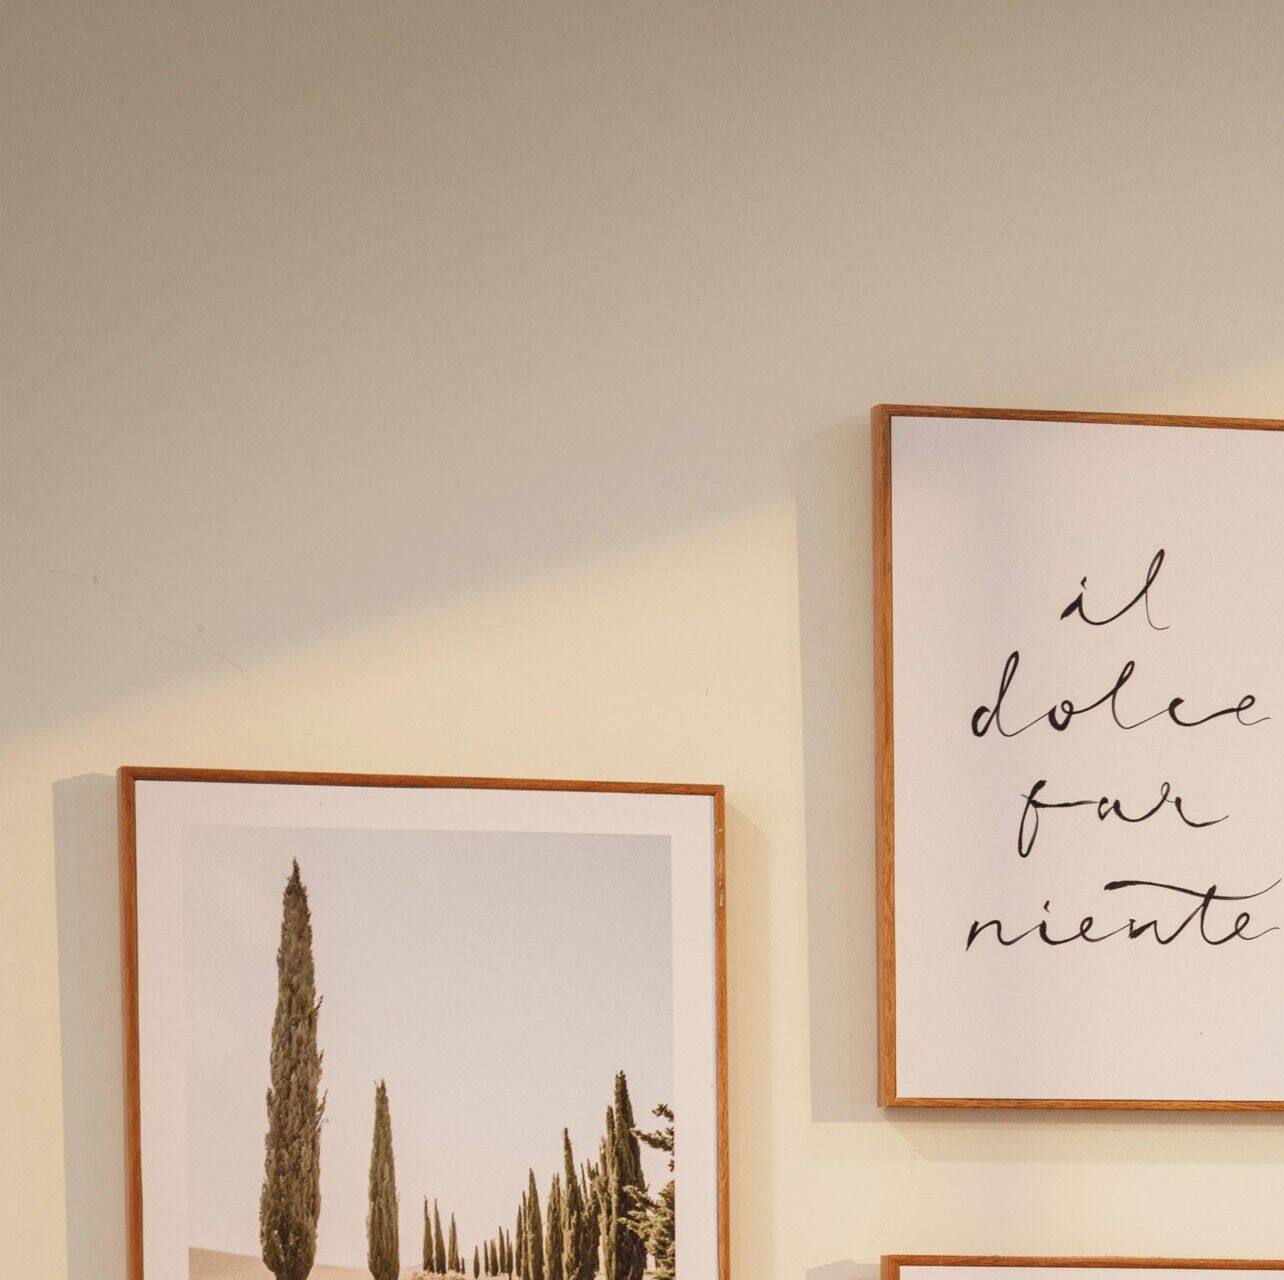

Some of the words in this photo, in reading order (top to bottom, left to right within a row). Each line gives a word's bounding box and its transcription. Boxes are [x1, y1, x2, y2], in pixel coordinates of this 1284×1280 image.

[1060, 548, 1170, 631] il
[970, 649, 1272, 738] dolce
[1016, 778, 1230, 859] far
[965, 878, 1283, 952] niente
